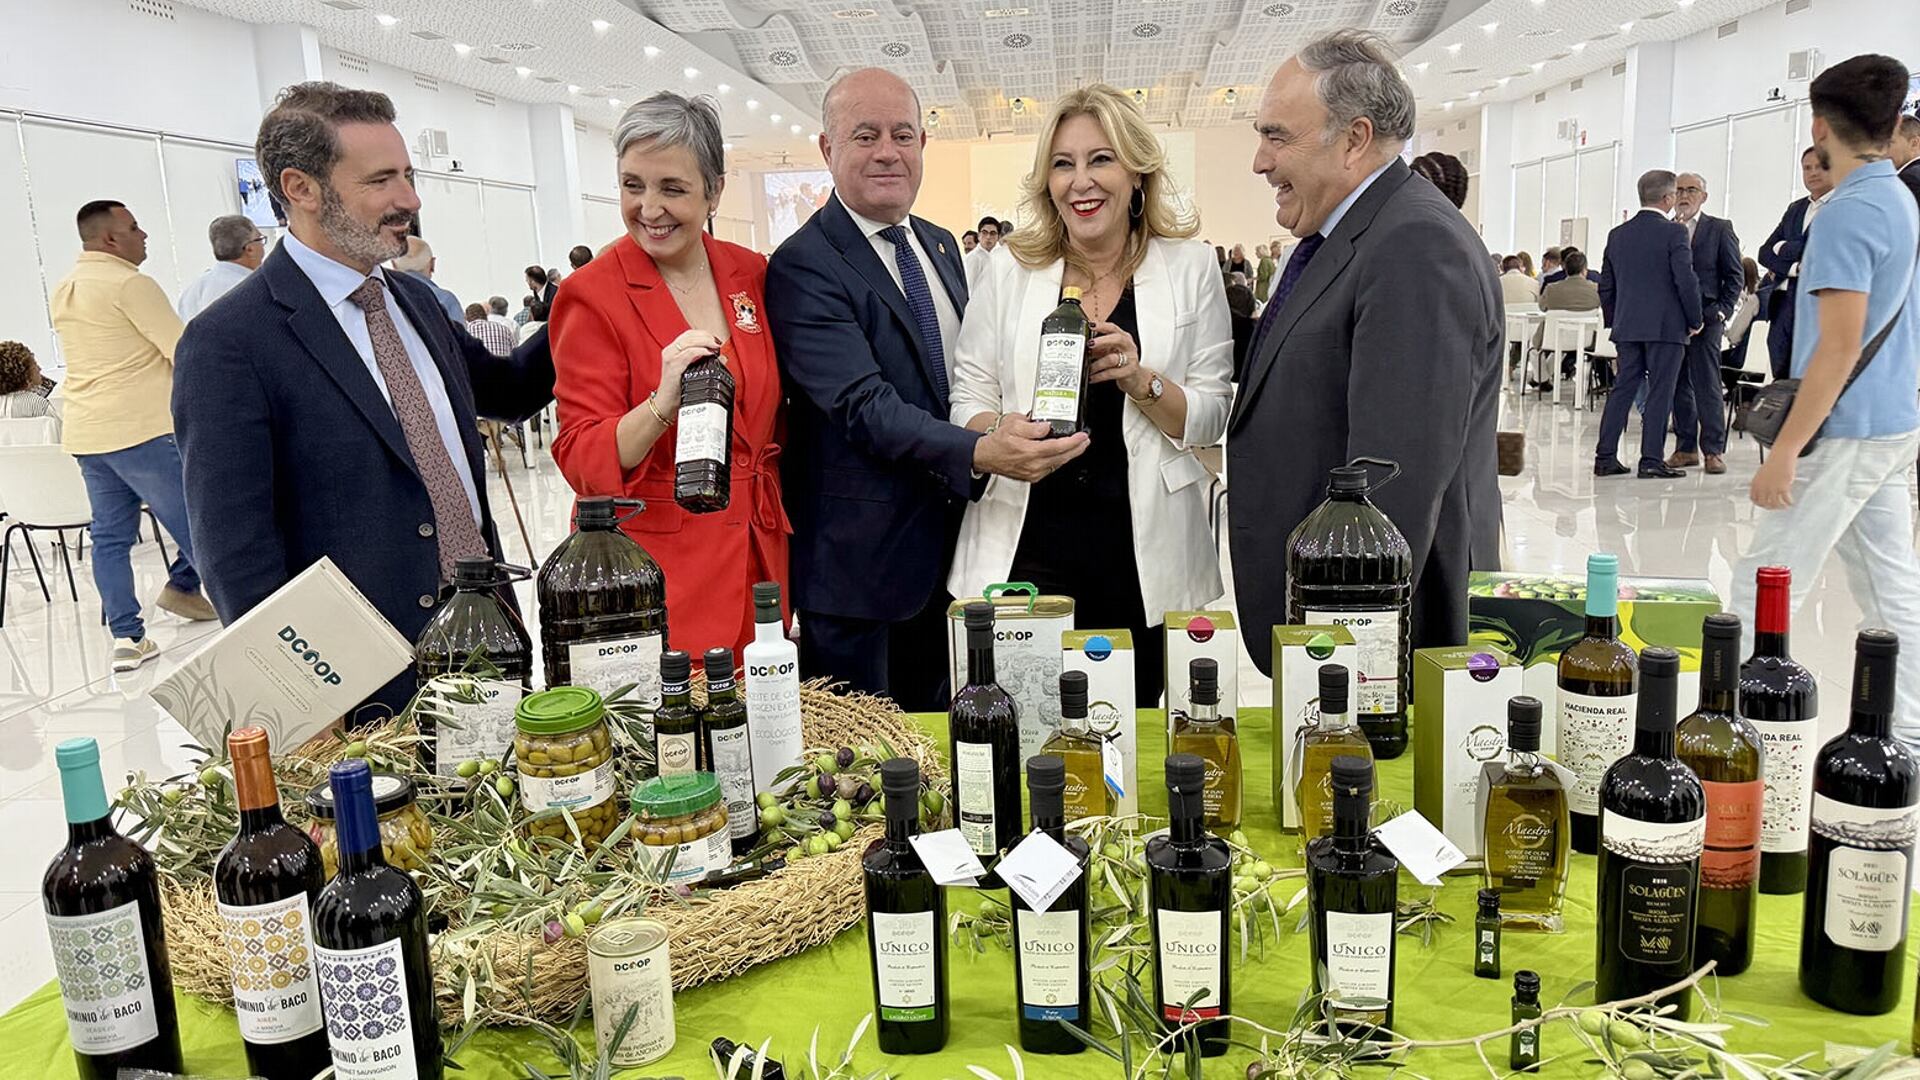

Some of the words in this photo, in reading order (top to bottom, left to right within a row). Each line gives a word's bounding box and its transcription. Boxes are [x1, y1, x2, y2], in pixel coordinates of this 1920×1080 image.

[1333, 617, 1372, 626] DCOOP
[995, 631, 1033, 641] COOP
[278, 625, 342, 686] DCOOP
[598, 644, 639, 656] DCOOP
[750, 662, 795, 676] DCOOP
[1565, 703, 1604, 715] HACIENDA
[1606, 707, 1626, 715] REAL
[1459, 734, 1507, 748] Maestro
[1502, 822, 1552, 835] Maestro
[1838, 867, 1899, 883] SOLAGÜEN
[1629, 884, 1686, 898] SOLAGÜEN
[614, 958, 651, 971] DCOOP
[281, 992, 308, 1009] BACO
[114, 1001, 142, 1018] BACO
[373, 1044, 401, 1062] BACO
